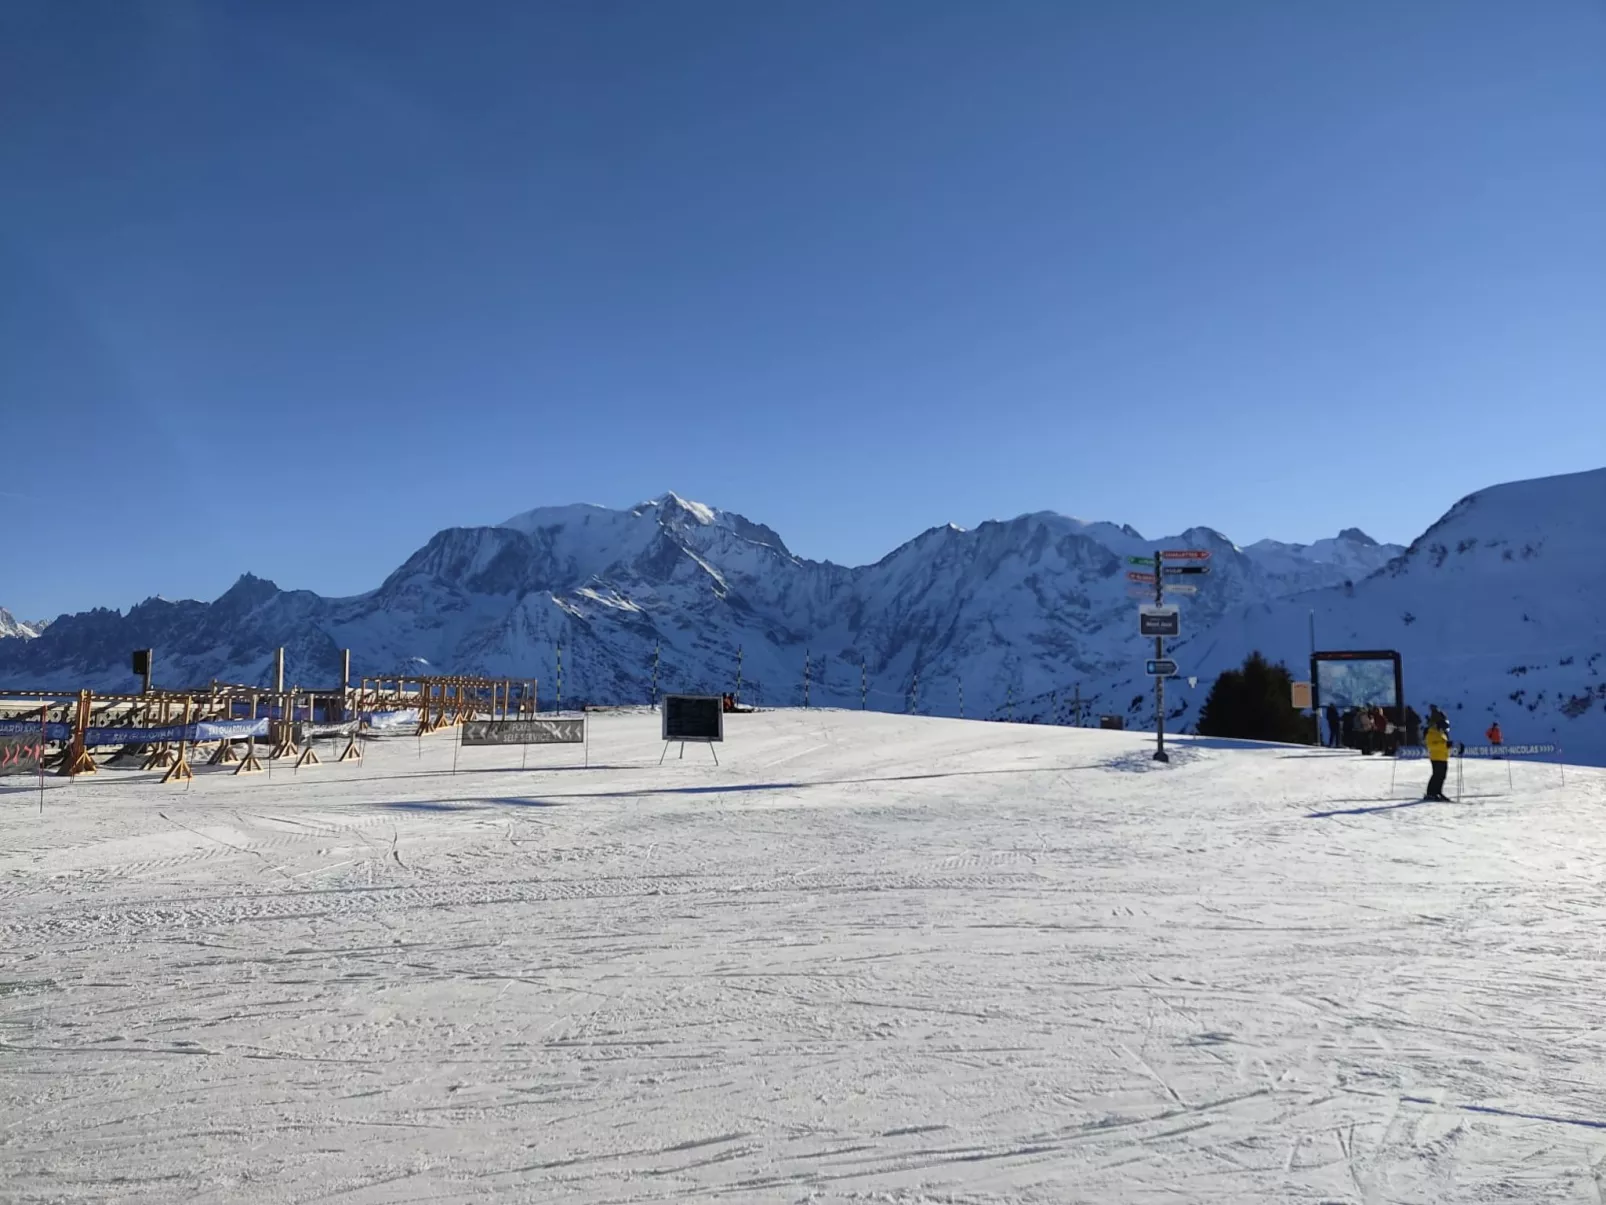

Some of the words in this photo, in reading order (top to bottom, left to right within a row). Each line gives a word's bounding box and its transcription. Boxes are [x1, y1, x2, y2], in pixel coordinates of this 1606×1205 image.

[208, 727, 219, 736] SKI
[219, 725, 252, 735] GUARDIAN
[503, 733, 519, 742] SELF
[519, 732, 552, 742] SERVICE
[1479, 746, 1488, 756] DE
[1489, 745, 1538, 756] SAINT-NICOLAS
